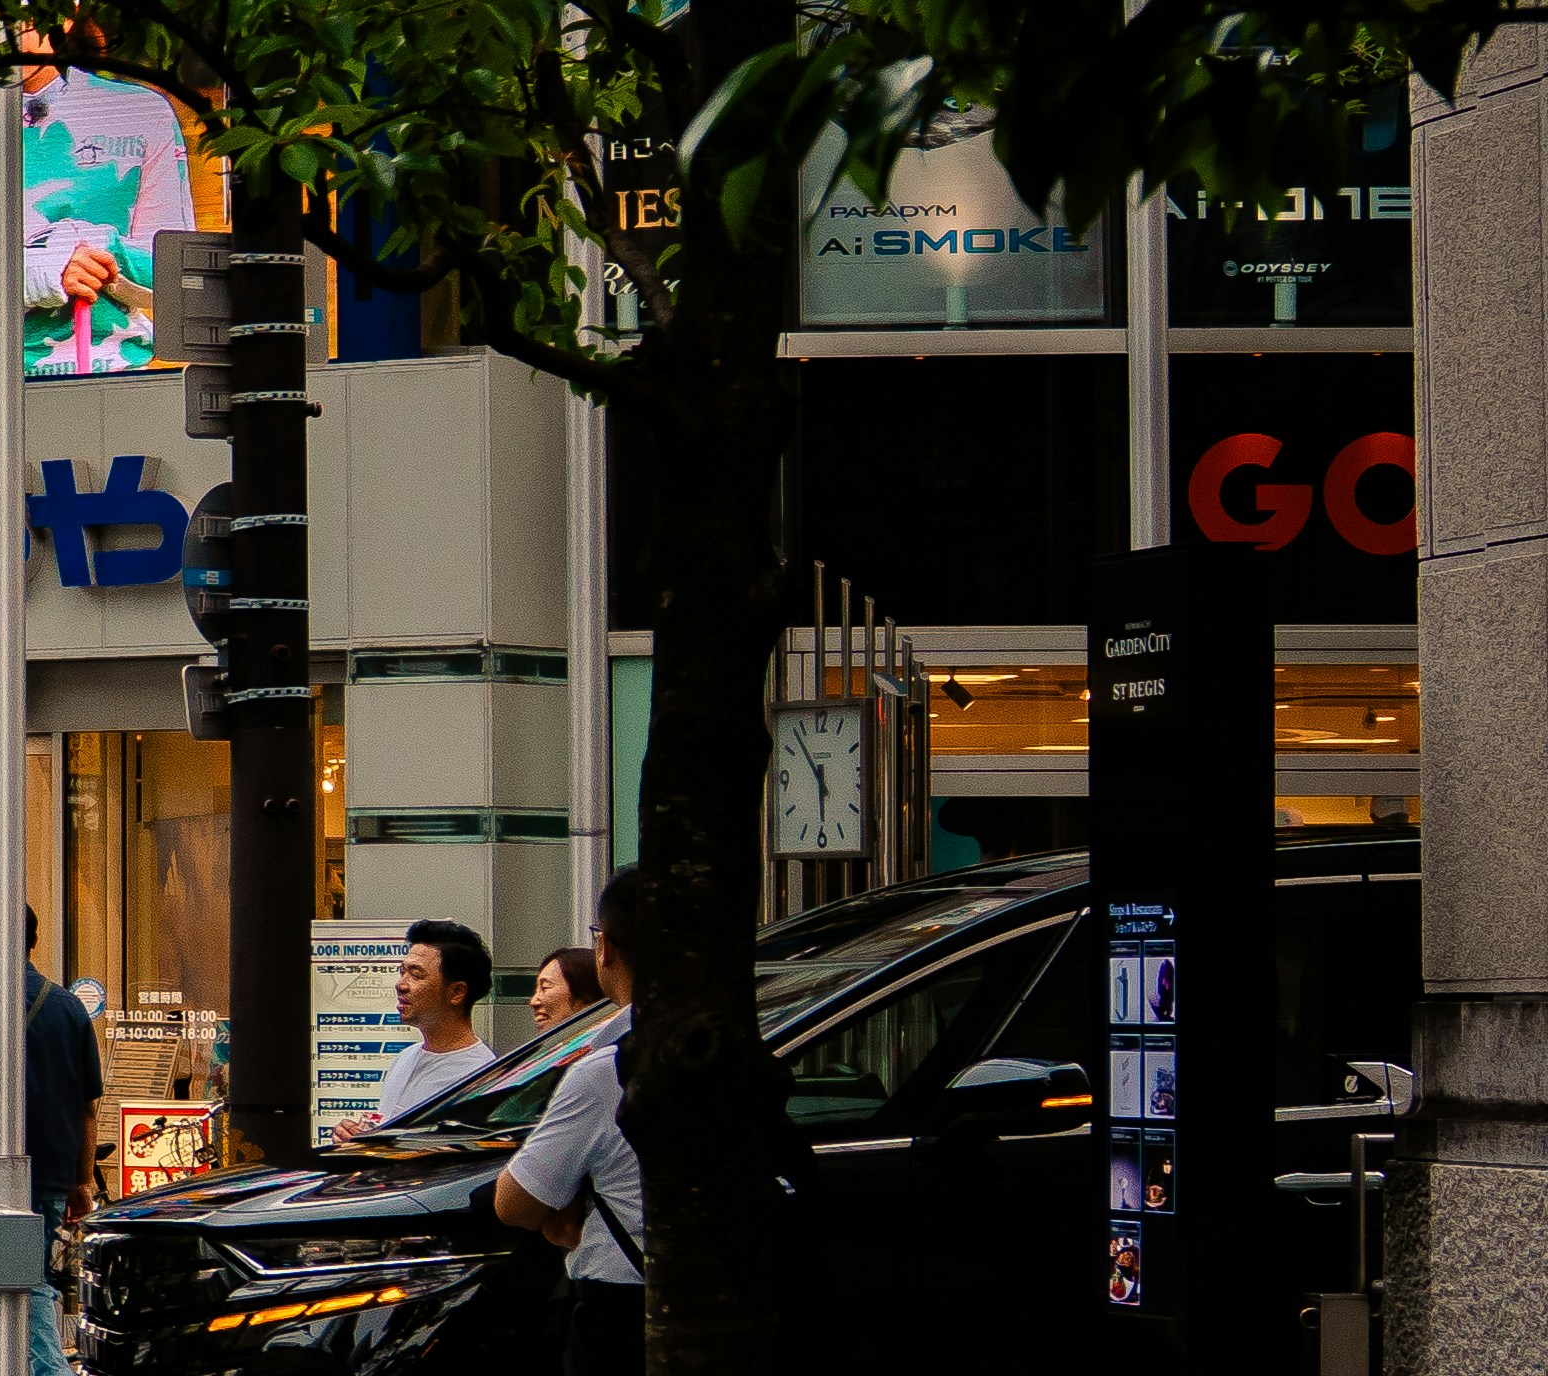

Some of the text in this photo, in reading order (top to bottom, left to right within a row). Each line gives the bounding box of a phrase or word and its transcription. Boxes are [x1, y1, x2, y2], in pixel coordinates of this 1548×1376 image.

[829, 204, 958, 222] PARADYM
[818, 226, 1090, 257] Ai SMOKE
[1240, 263, 1332, 273] ODYSSEY
[1106, 632, 1173, 658] GARDEN CITY
[1128, 678, 1166, 699] REGIS
[137, 991, 183, 1005] 営業時間
[128, 1010, 163, 1023] 10:00
[128, 1027, 163, 1040] 10:00
